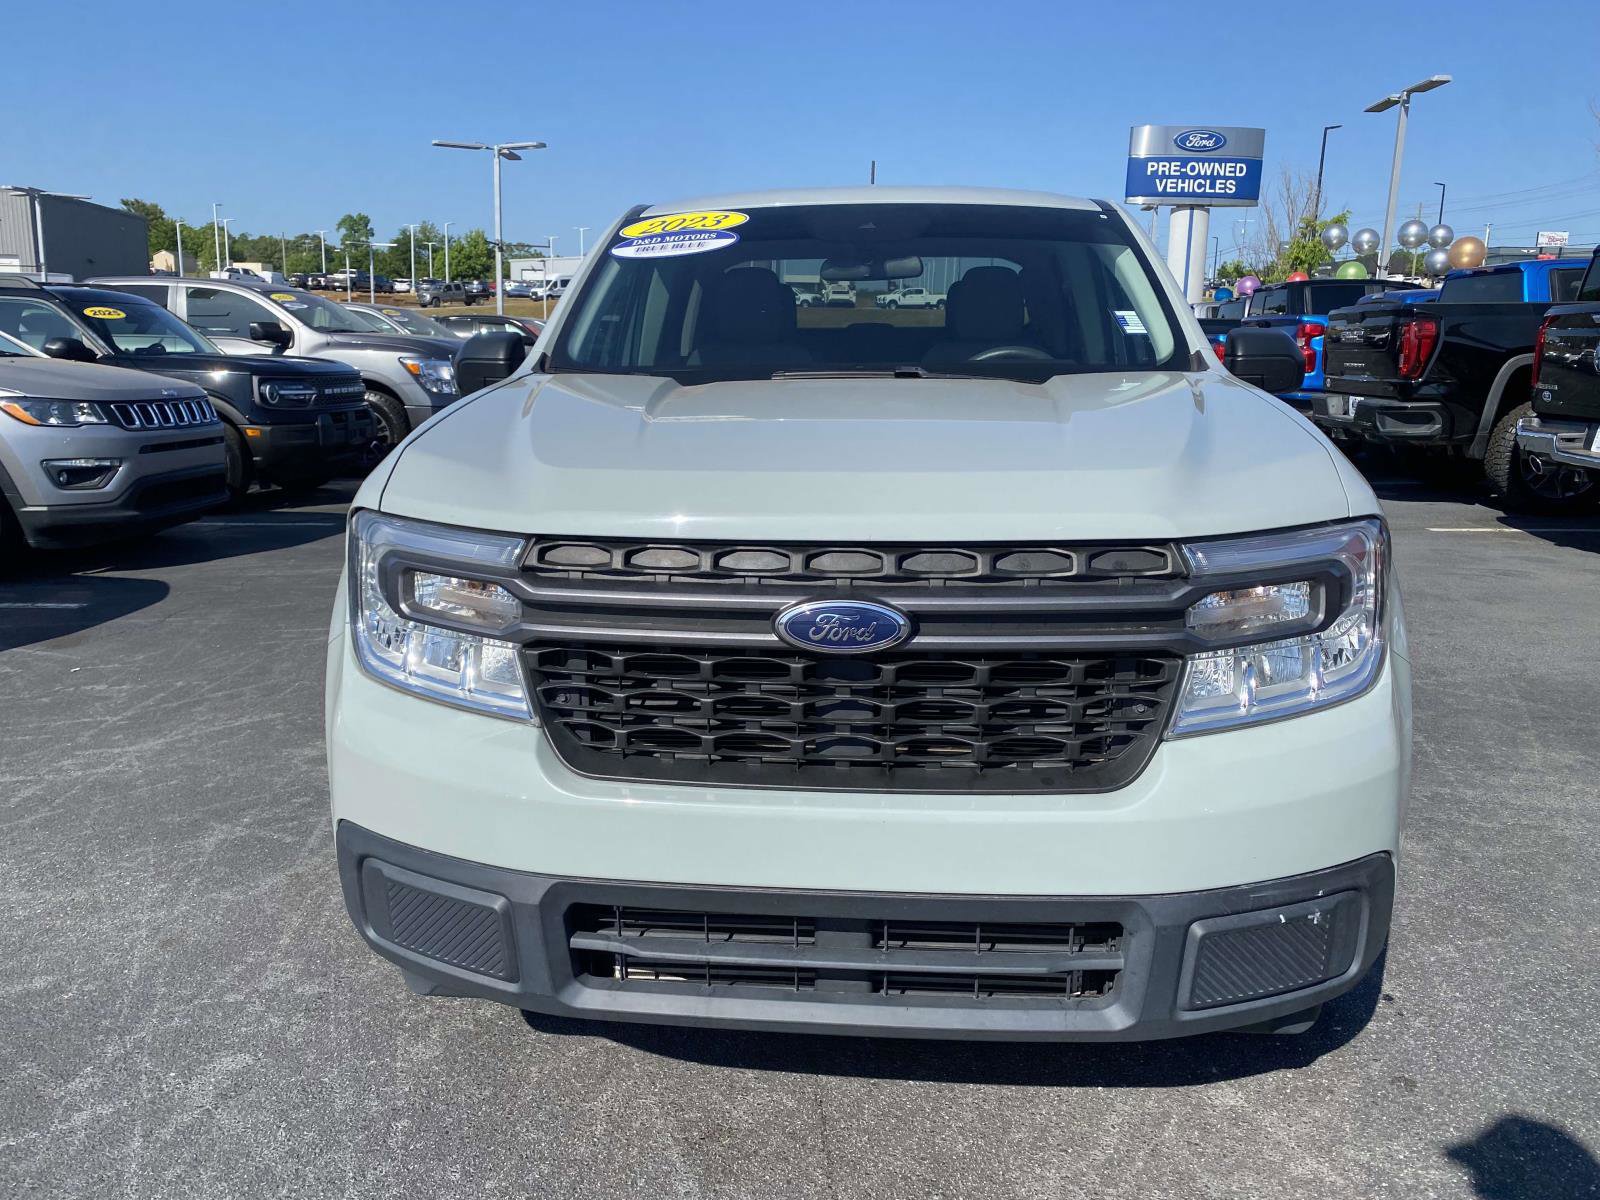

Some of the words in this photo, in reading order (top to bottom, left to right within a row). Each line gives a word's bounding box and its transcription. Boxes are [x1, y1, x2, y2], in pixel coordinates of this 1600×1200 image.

[1186, 133, 1216, 147] Ford
[1146, 161, 1247, 177] PRE-OWNED
[1155, 178, 1236, 194] VEHICLES
[638, 214, 730, 235] 2023
[632, 236, 662, 246] D&D
[663, 232, 718, 243] MOTORS
[671, 240, 706, 250] BLUE
[808, 613, 878, 642] Ford
